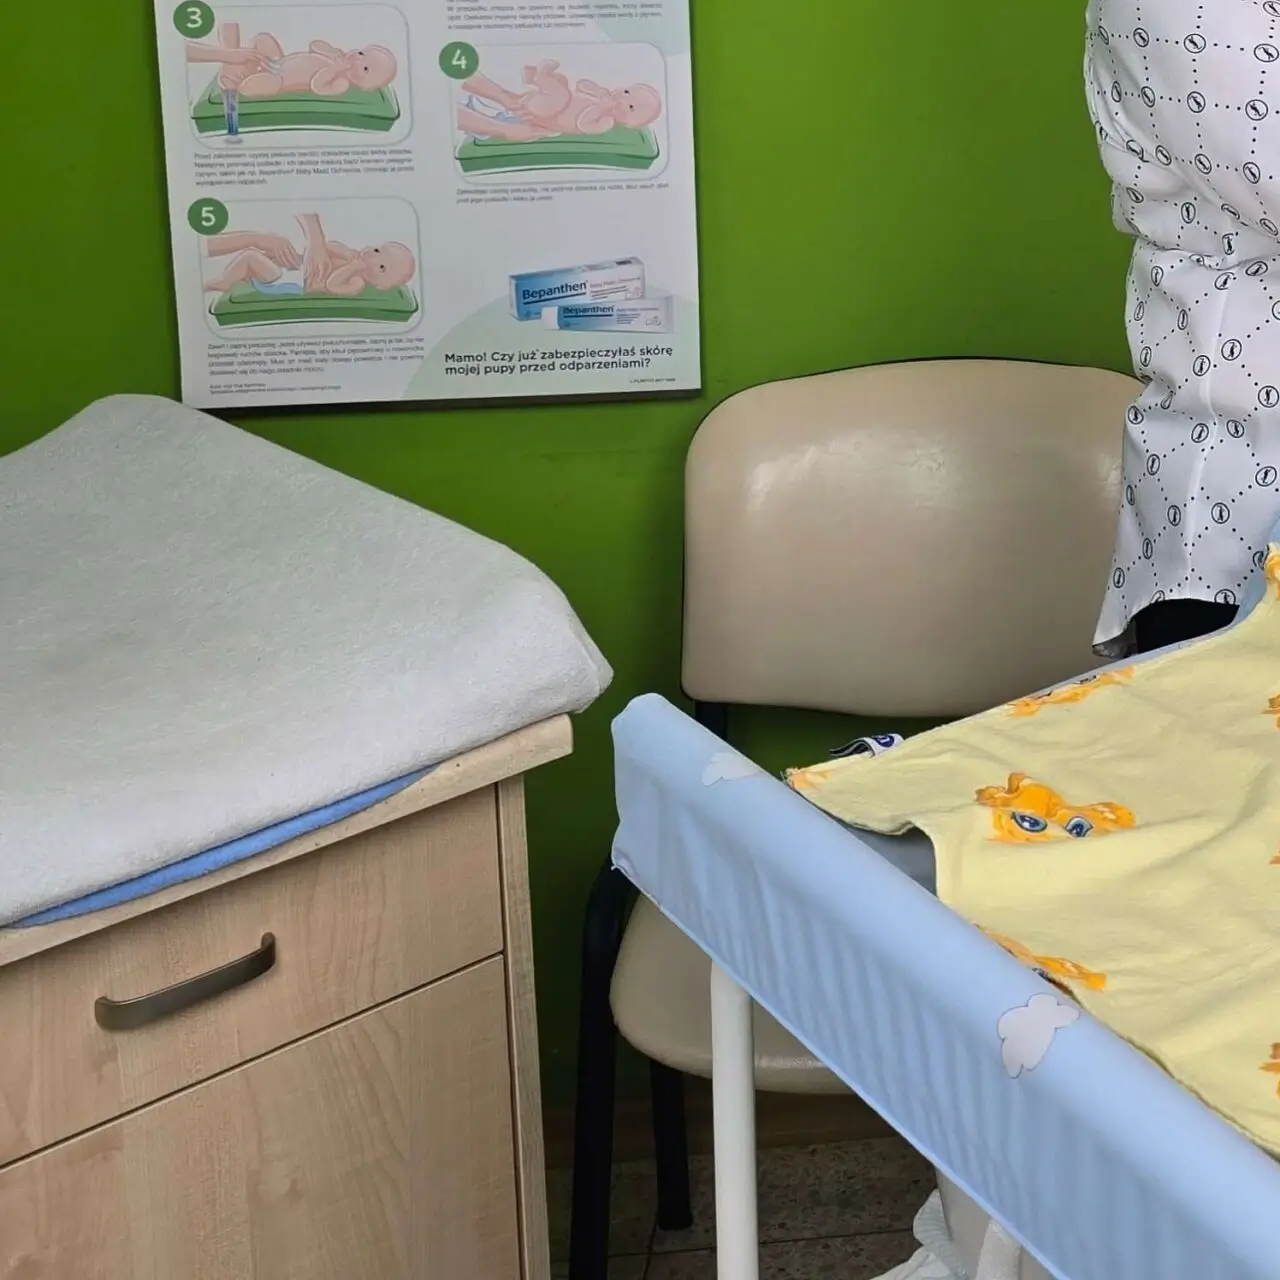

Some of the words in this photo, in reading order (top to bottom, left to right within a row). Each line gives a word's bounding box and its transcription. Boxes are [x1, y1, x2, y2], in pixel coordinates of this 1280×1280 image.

[186, 8, 203, 29] 3
[451, 49, 467, 69] 4
[201, 207, 216, 227] 5
[522, 281, 587, 300] Bepanthen
[445, 352, 487, 363] Mamo!
[491, 351, 515, 363] Czy
[540, 346, 636, 360] zabezpieczyłaś
[640, 345, 673, 357] skórę
[445, 363, 481, 376] mojej
[484, 364, 516, 375] pupy
[519, 361, 556, 374] przed
[559, 358, 651, 372] odparzeniami?
